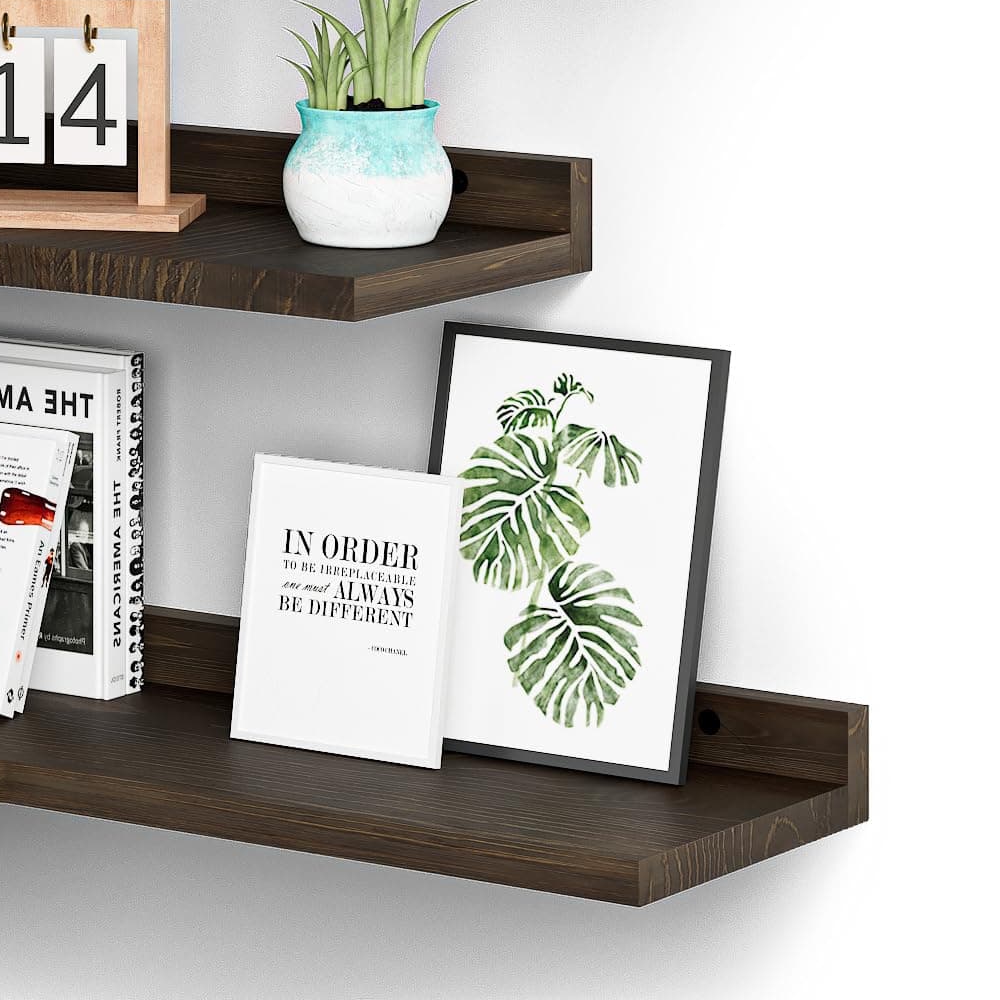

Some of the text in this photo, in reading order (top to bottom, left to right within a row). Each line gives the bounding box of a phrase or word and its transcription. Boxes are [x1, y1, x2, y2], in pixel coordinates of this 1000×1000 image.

[282, 529, 419, 571] IN ORDER
[282, 559, 416, 586] TO BE IRREPLACEABLE
[20, 540, 45, 641] An Eames Primer
[282, 580, 414, 609] one must ALWAYS
[278, 595, 414, 628] BE DIFFERENT
